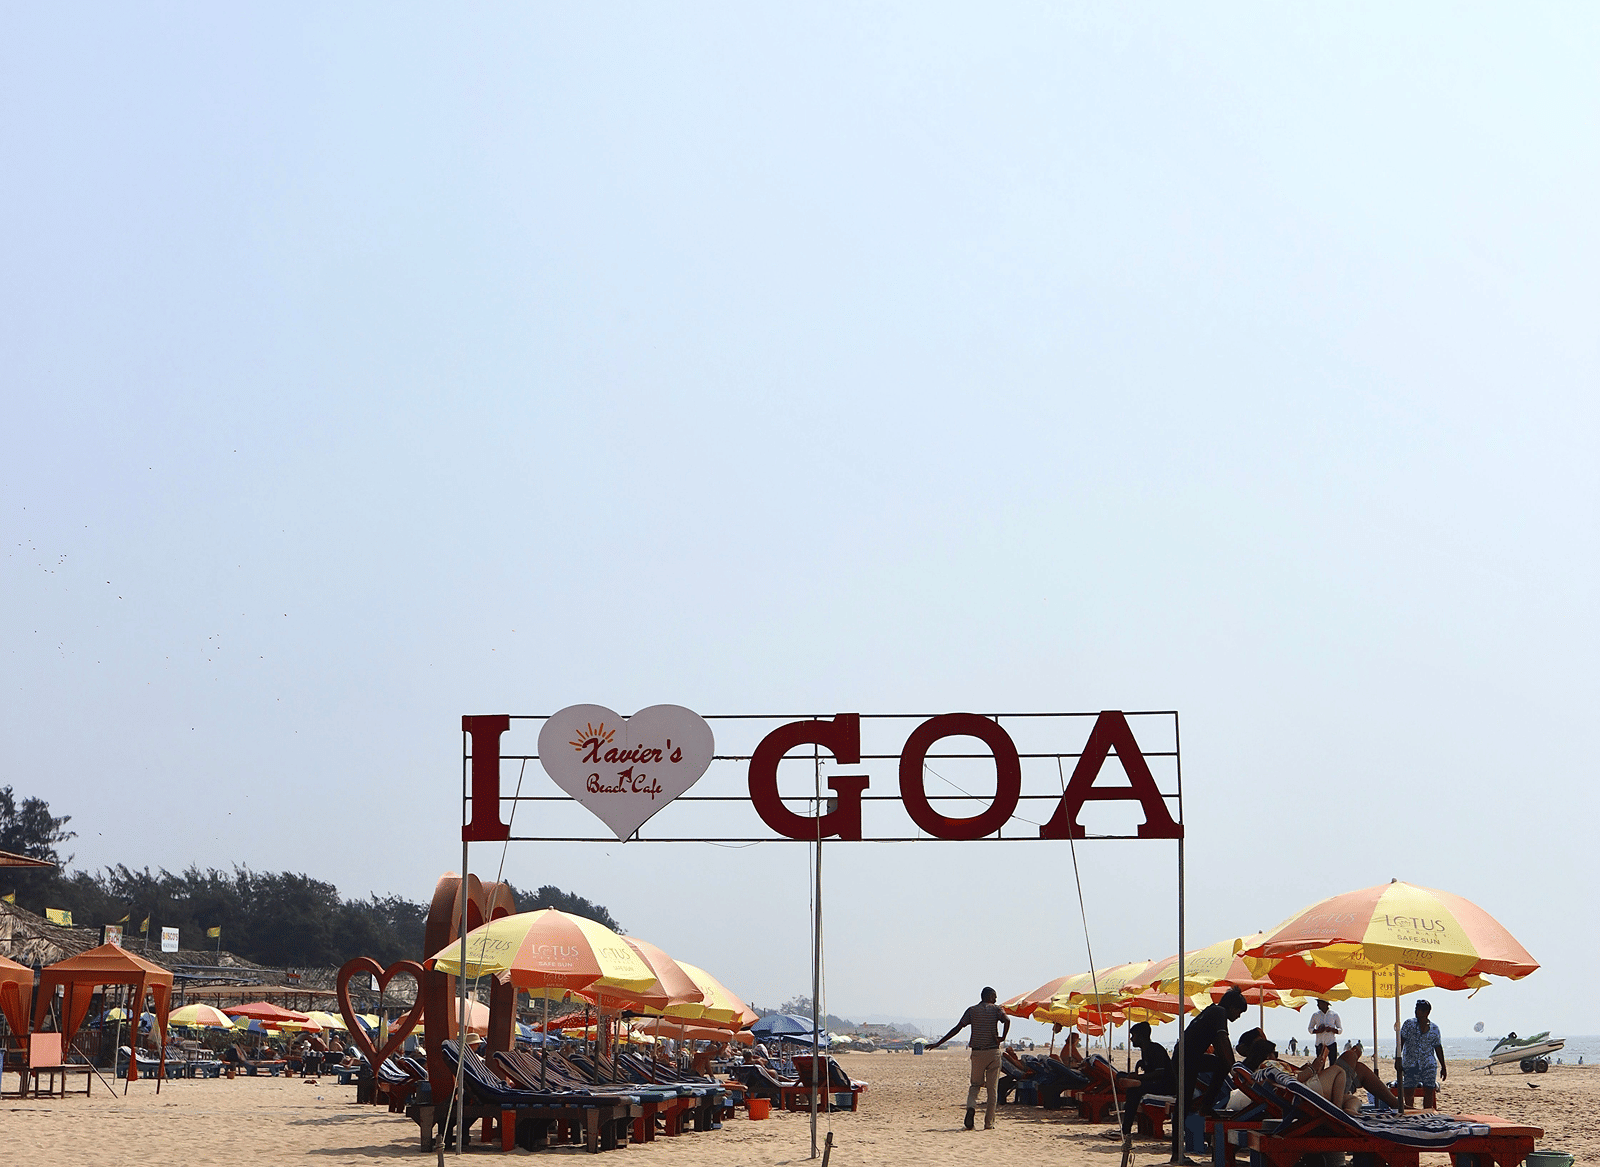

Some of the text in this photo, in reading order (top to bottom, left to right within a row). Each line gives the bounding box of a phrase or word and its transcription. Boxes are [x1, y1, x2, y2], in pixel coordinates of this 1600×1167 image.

[582, 738, 683, 764] Xavier's
[462, 711, 1184, 841] I GOA
[587, 770, 663, 800] Beach Cafe
[1385, 914, 1446, 932] LOTUS
[1397, 934, 1441, 945] SAFE SUN
[532, 944, 579, 957] LOTUS
[1402, 949, 1433, 960] LOTUS
